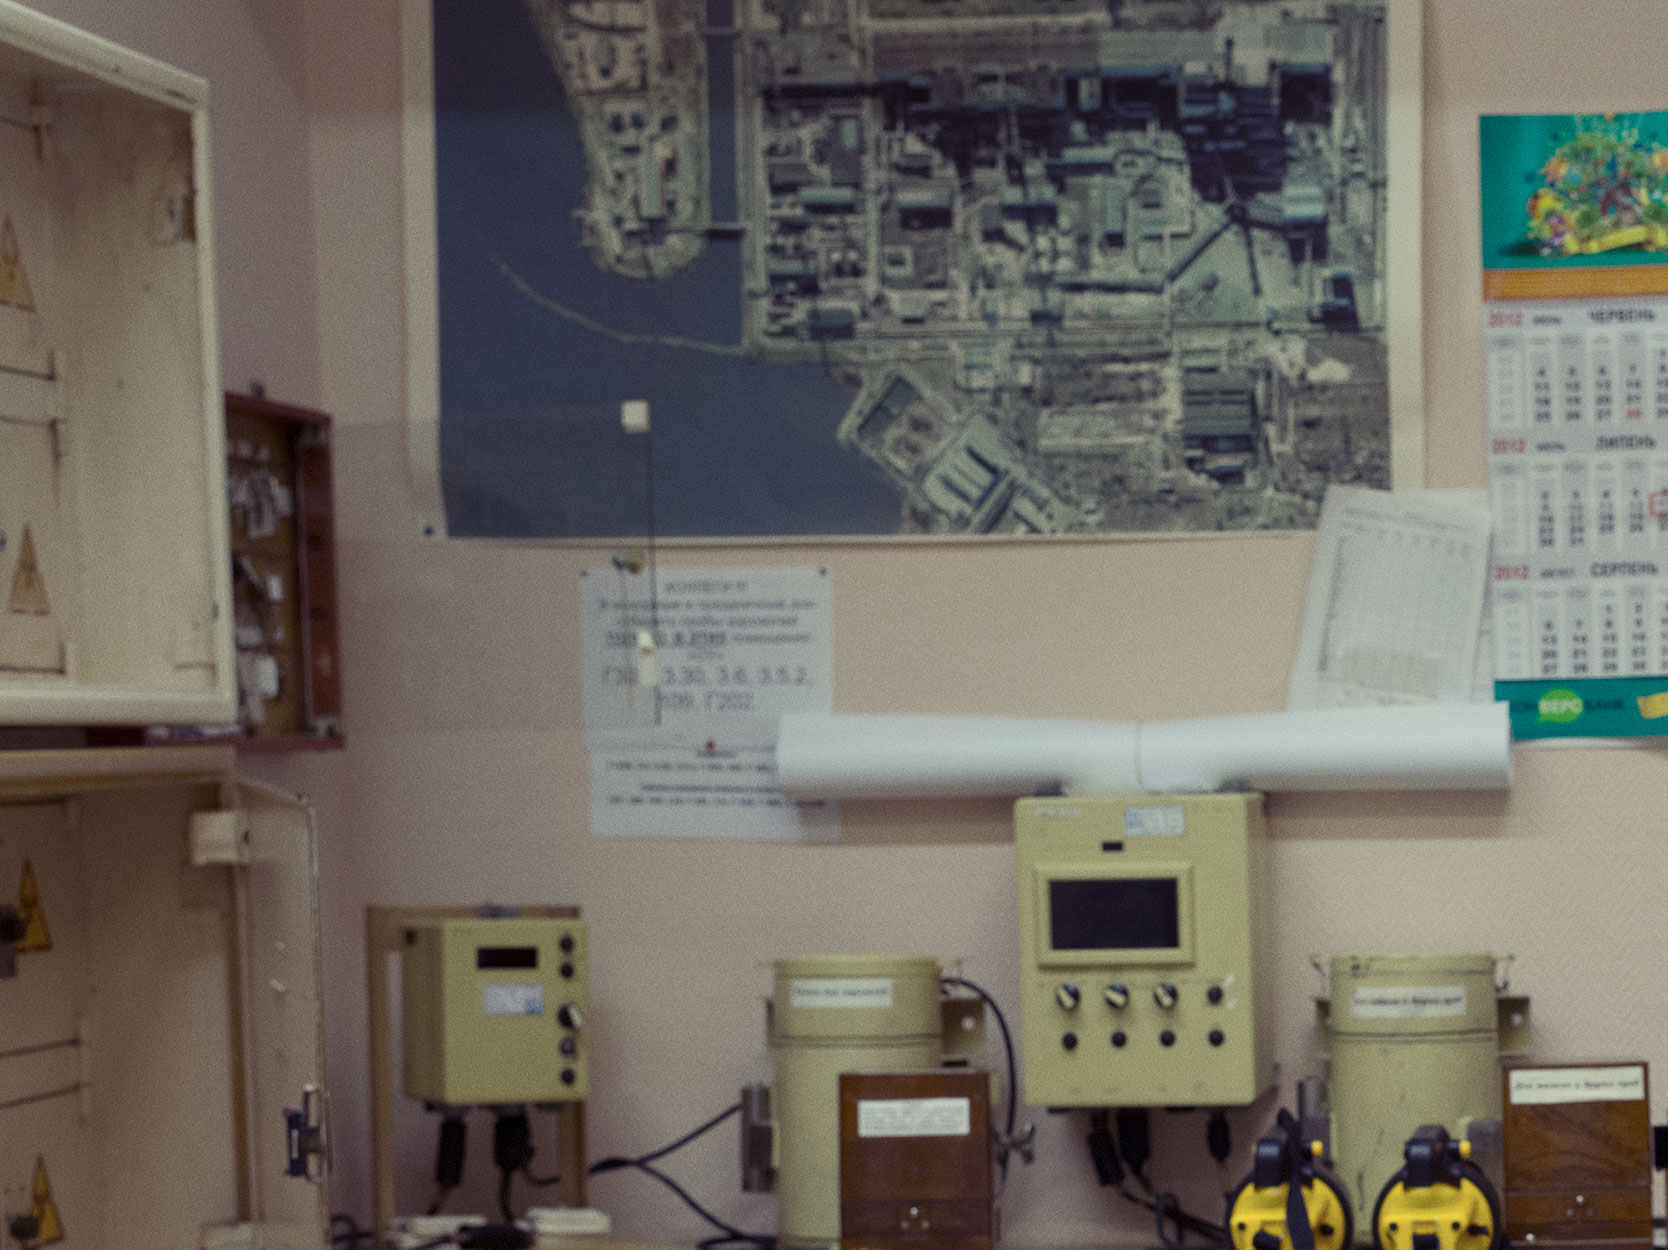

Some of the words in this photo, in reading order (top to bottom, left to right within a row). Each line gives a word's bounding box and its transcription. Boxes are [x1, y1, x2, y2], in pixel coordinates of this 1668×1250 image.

[1589, 310, 1656, 322] ЧЕРВЕНЬ
[1596, 435, 1657, 449] ЛИПЕНЬ
[1591, 563, 1658, 577] СЕРПЕНЬ
